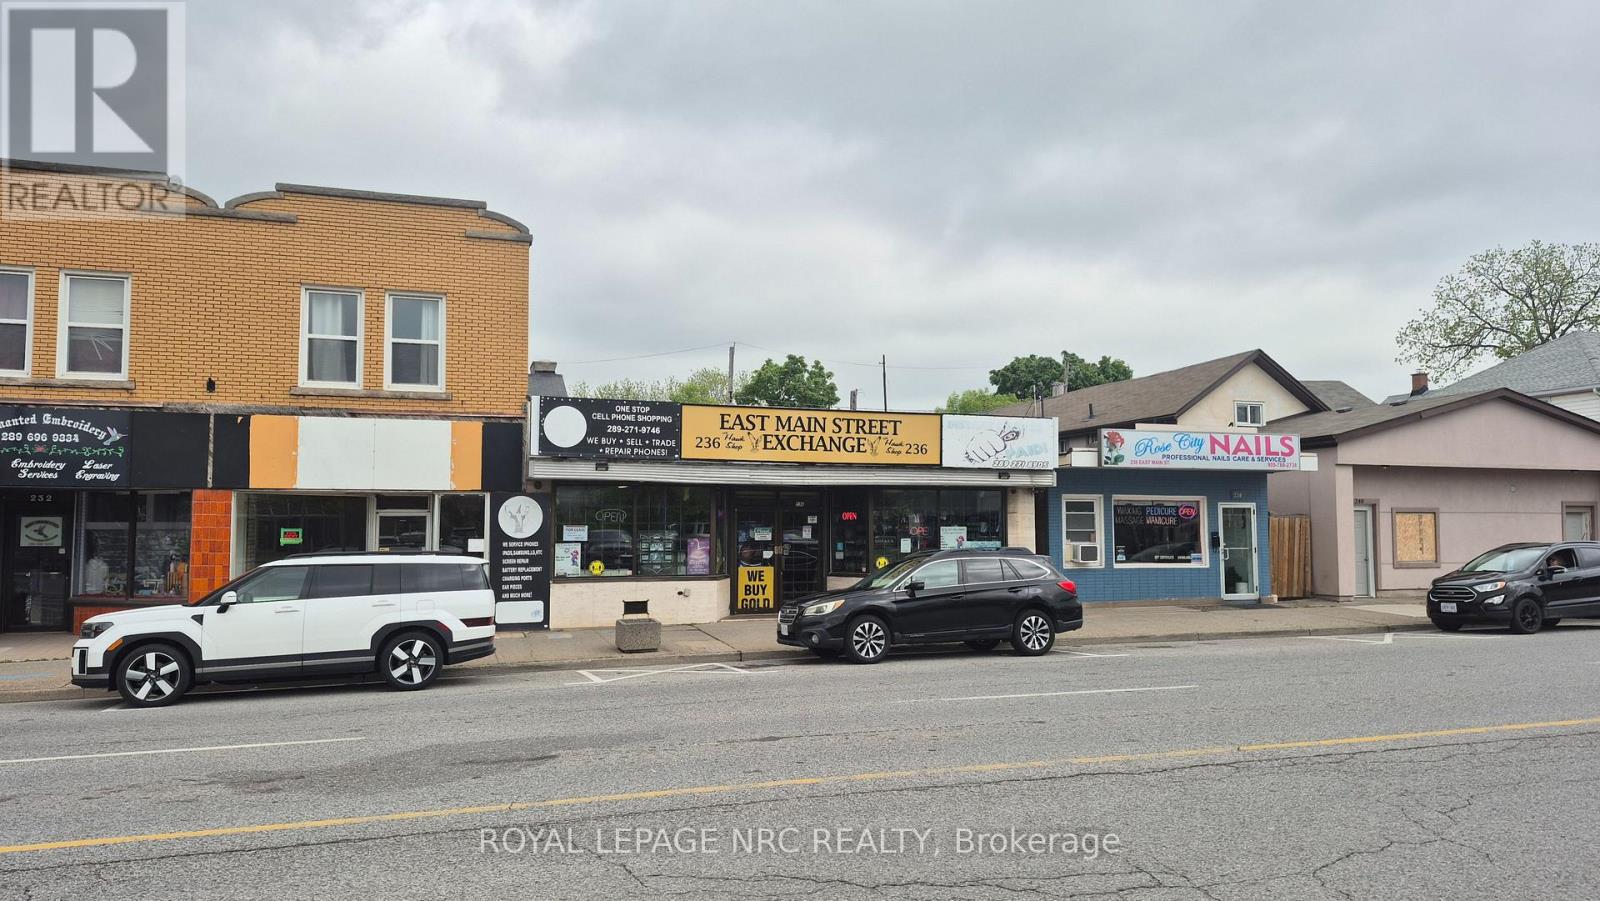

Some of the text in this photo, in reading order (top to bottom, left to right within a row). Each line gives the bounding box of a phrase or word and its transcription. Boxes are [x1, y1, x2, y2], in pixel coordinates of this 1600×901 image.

[637, 414, 672, 423] SHOPPING
[720, 413, 902, 436] EAST MAIN STREET
[42, 413, 106, 440] Embroidery
[607, 425, 660, 434] 289-271-9746
[1, 432, 80, 442] 289 696 9334
[695, 436, 720, 448] 236
[762, 434, 868, 454] EXCHANGE
[905, 443, 928, 455] 236
[1134, 432, 1295, 458] Rose City NAILS
[11, 458, 114, 470] Embroidery Laser
[1162, 454, 1210, 462] PROFESSIONAL
[18, 469, 120, 481] Services Engraving
[596, 510, 627, 522] OPEN
[842, 512, 857, 520] OPEN
[1146, 506, 1177, 516] PEDICURE
[1146, 516, 1177, 525] MANICURE
[747, 570, 764, 582] WE
[744, 584, 767, 596] BUY
[741, 598, 770, 609] GOLD
